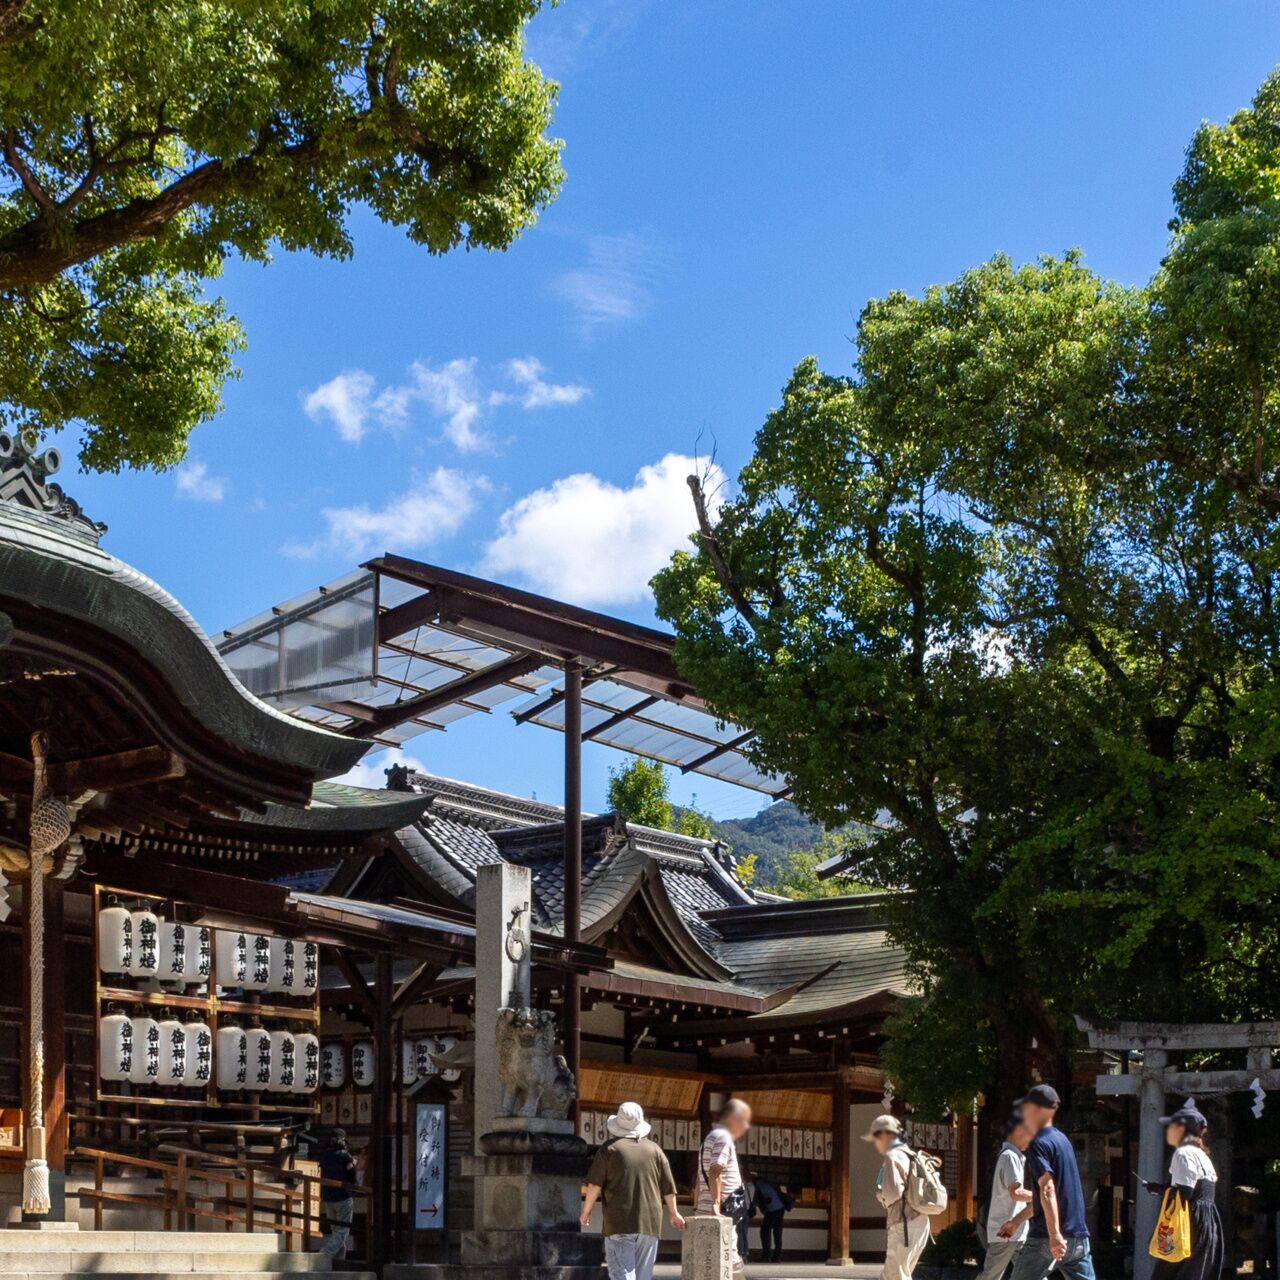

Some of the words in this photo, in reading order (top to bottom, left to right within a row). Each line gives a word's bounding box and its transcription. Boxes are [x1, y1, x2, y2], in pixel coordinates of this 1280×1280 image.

[139, 918, 157, 969] 御神燈
[254, 936, 269, 984] 御神燈
[304, 943, 317, 988] 御神燈
[171, 1028, 185, 1079] 御神燈
[195, 1031, 210, 1080] 御神燈
[257, 1035, 271, 1084] 御神燈
[280, 1038, 294, 1086] 御神燈
[304, 1041, 318, 1089] 御神燈
